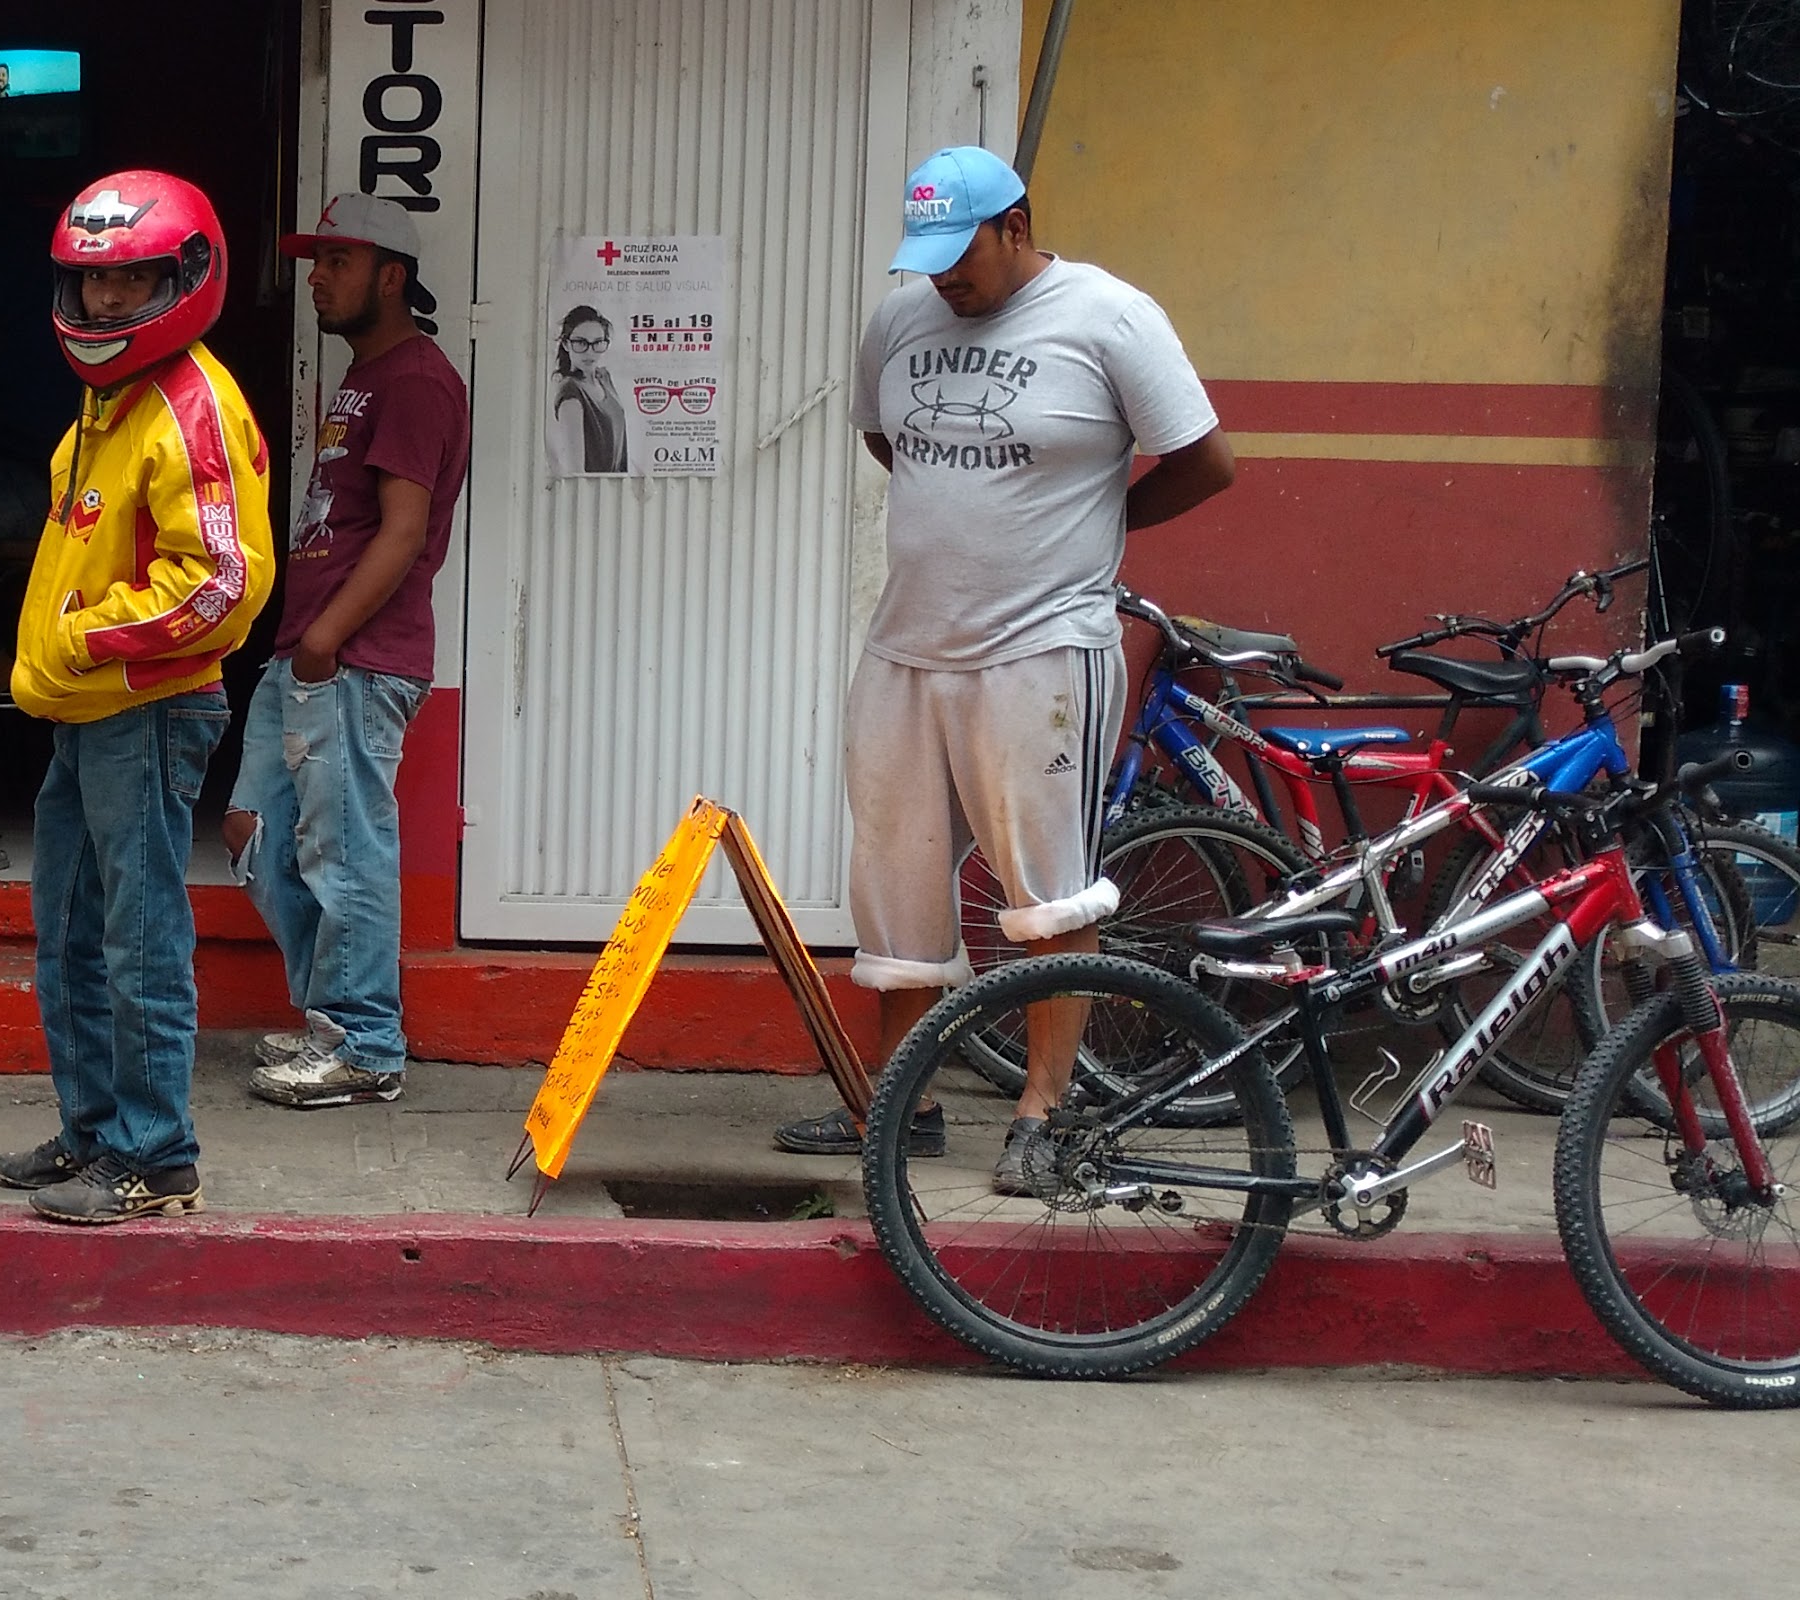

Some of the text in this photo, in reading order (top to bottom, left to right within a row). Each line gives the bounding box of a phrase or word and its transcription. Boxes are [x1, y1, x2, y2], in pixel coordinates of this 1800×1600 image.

[623, 244, 679, 253] CRUZ ROJA
[623, 254, 679, 263] MEXICANA
[562, 280, 713, 292] JORNADA DE SALUD VISUAL
[630, 314, 713, 328] 15 al 19
[656, 343, 670, 351] AM
[698, 343, 711, 351] PM
[909, 346, 1038, 390] UNDER
[633, 377, 663, 385] VENTA
[684, 377, 717, 386] LENTES
[654, 447, 715, 462] O&LM
[895, 431, 1036, 471] ARMOUR
[1043, 763, 1077, 775] adidas
[1426, 941, 1571, 1112] Raleigh
[1188, 1050, 1242, 1087] Raleigh
